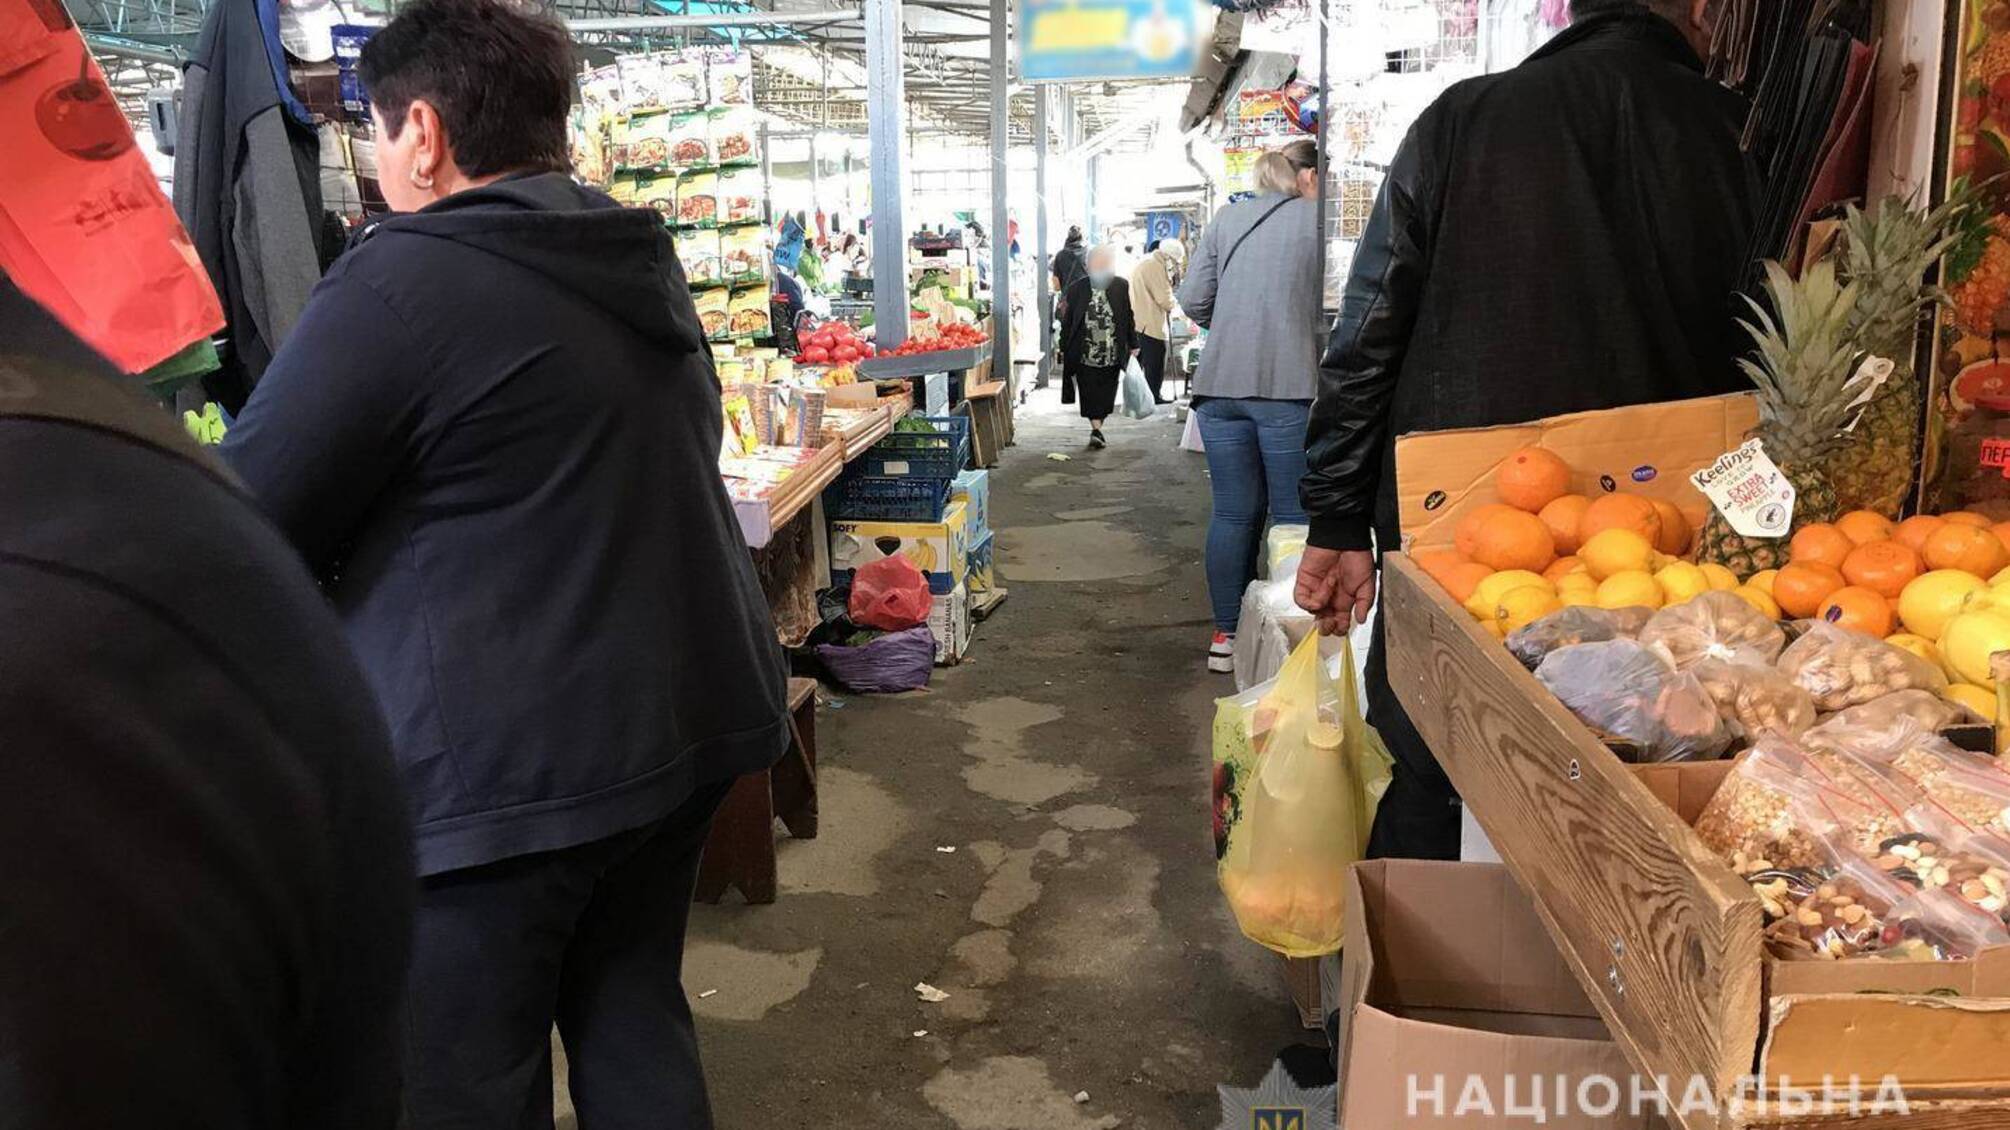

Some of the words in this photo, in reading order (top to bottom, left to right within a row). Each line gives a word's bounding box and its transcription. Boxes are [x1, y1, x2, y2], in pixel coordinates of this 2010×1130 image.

[1694, 446, 1757, 488] Keelings
[1727, 473, 1766, 498] EXTRA
[1735, 481, 1769, 507] SWEET
